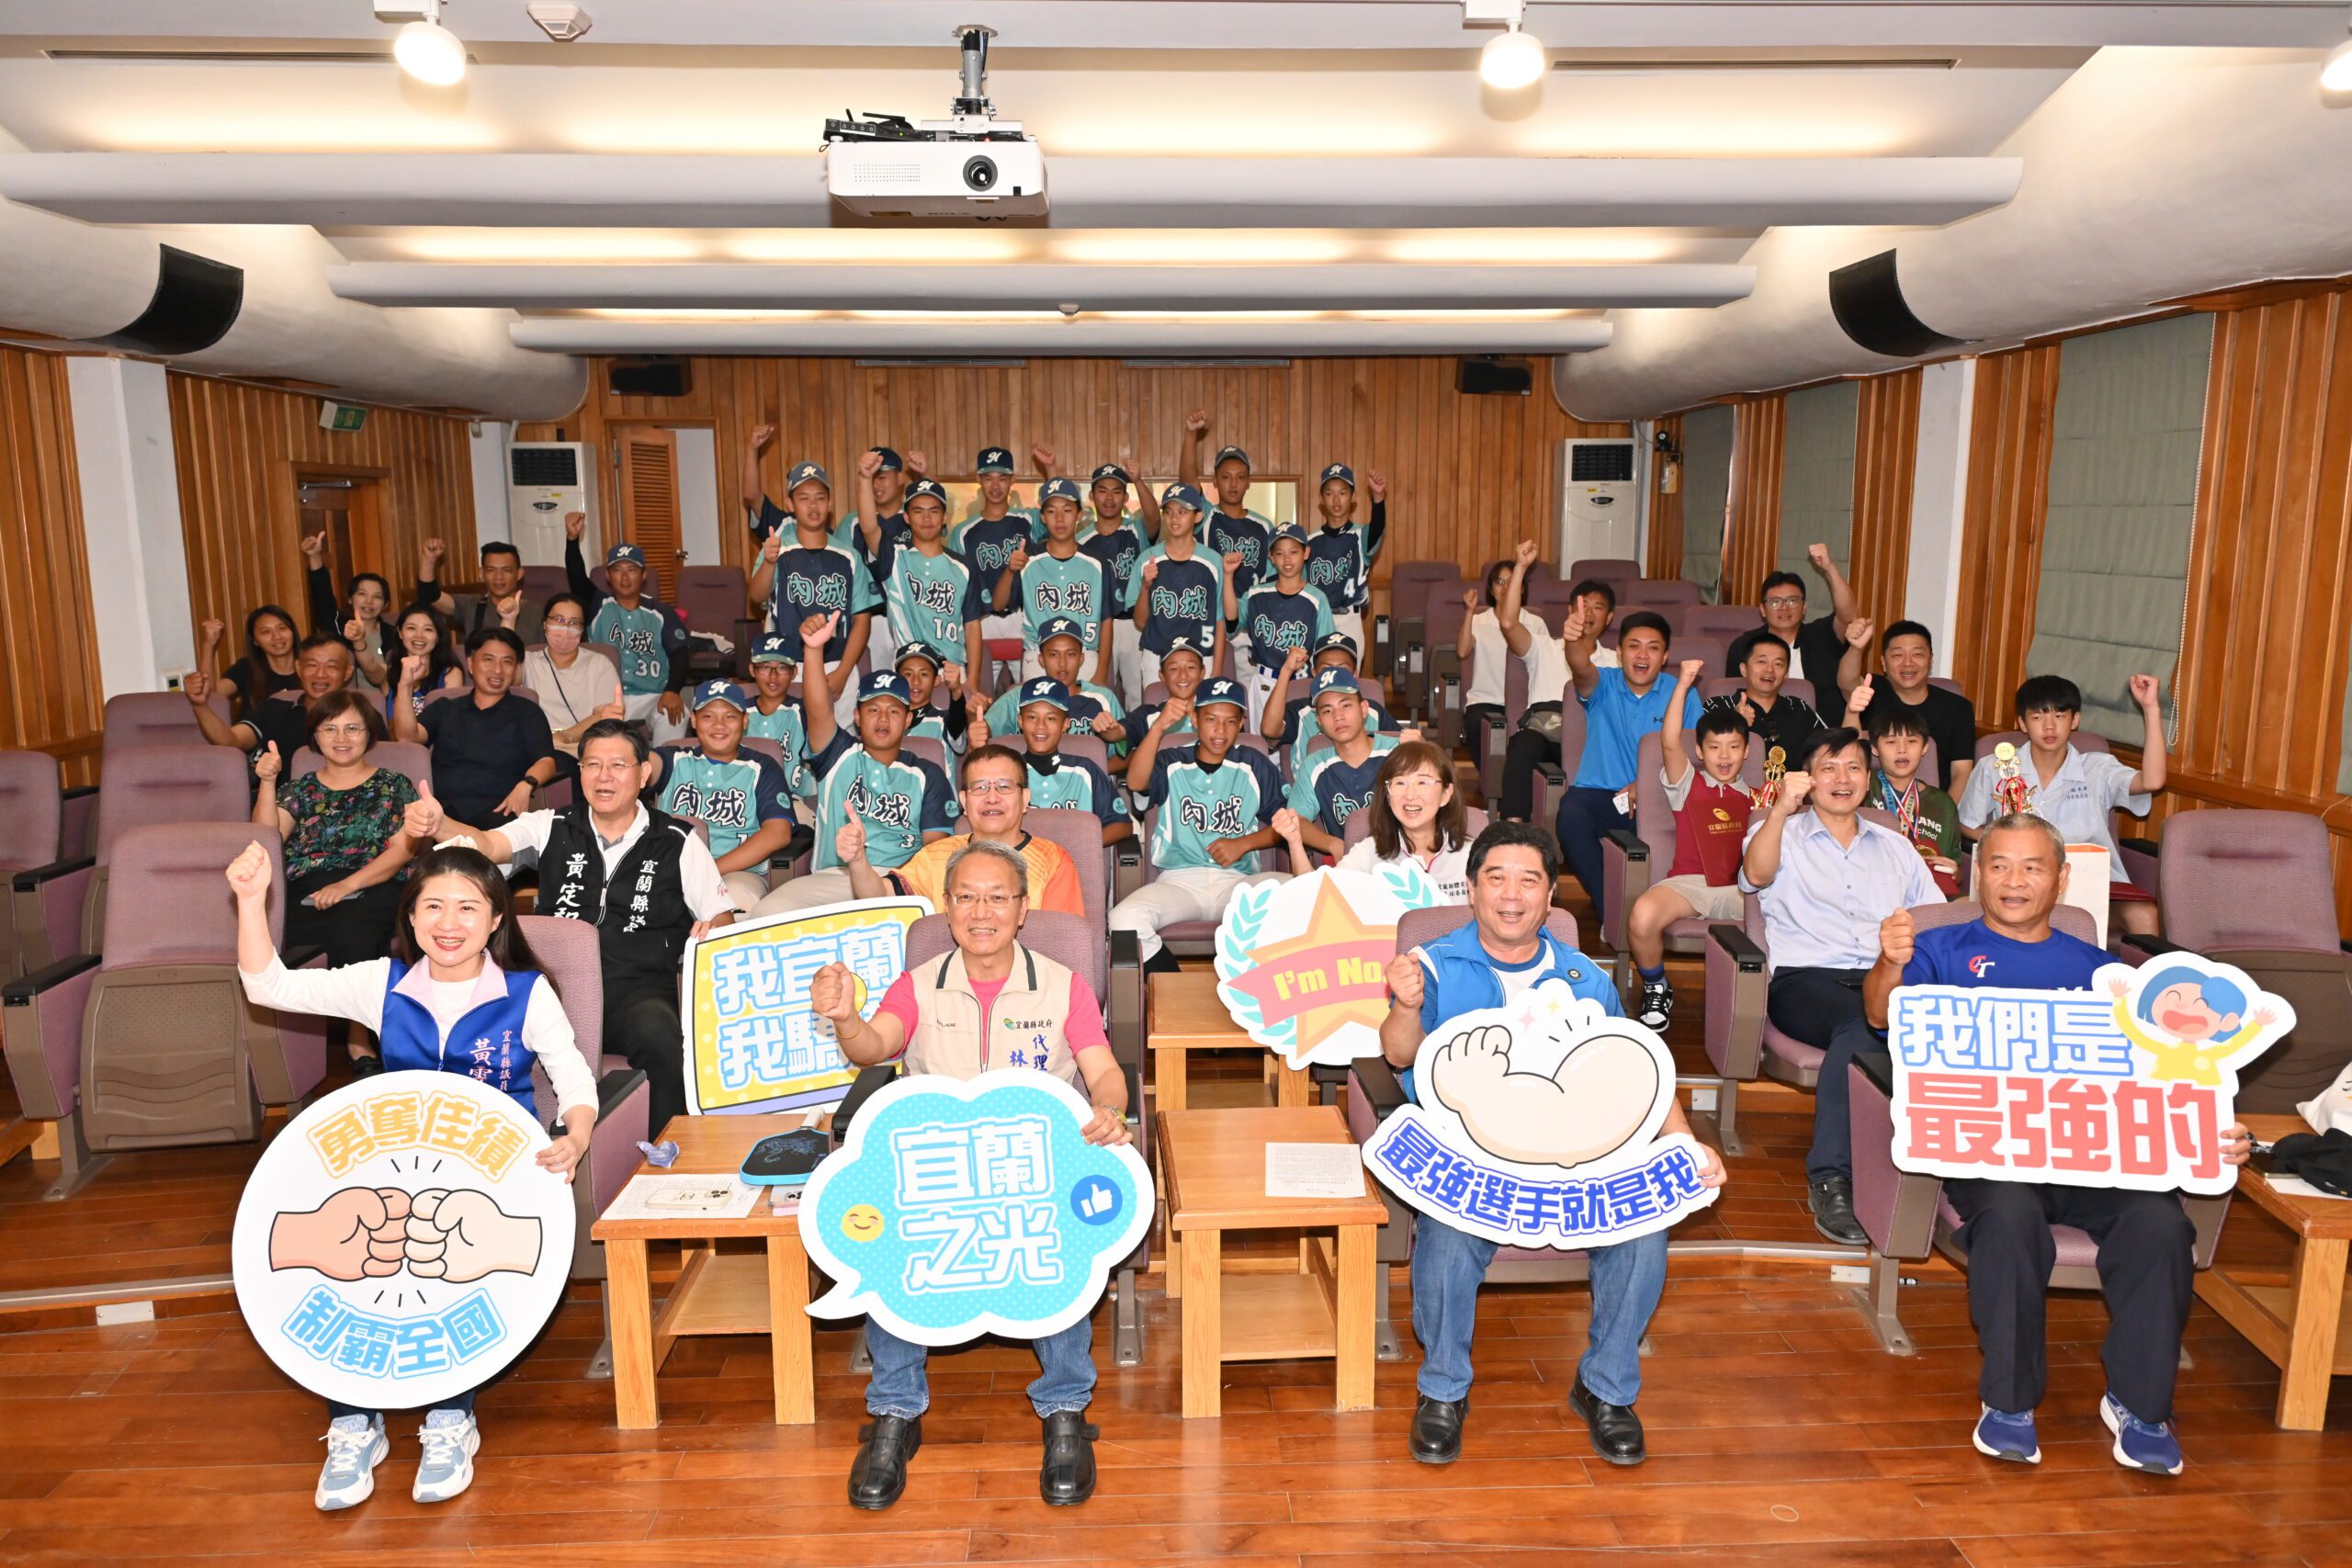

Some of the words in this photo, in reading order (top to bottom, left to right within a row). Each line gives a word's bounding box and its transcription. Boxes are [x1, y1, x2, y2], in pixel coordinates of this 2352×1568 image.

[787, 571, 847, 609] 內城
[1035, 581, 1092, 616] 內城
[1151, 585, 1208, 621] 內城
[1342, 577, 1356, 599] 4
[933, 617, 958, 642] 10
[1084, 622, 1098, 643] 5
[1201, 626, 1216, 647] 5
[634, 659, 662, 678] 30
[791, 764, 802, 788] 6
[672, 782, 748, 828] 內城
[1180, 794, 1244, 836] 內城
[898, 833, 916, 850] 3
[1272, 967, 1329, 1001] I'm
[718, 998, 879, 1089] 我驕
[1899, 995, 2134, 1077] 我們是
[1009, 1048, 1029, 1067] 林
[309, 1093, 527, 1179] 勇奪佳績
[1905, 1072, 2222, 1179] 最強的
[891, 1114, 1050, 1206] 宜蘭
[1377, 1120, 1702, 1234] 最強選手就是我
[902, 1201, 1061, 1292] 之光
[284, 1287, 504, 1376] 制霸全國
